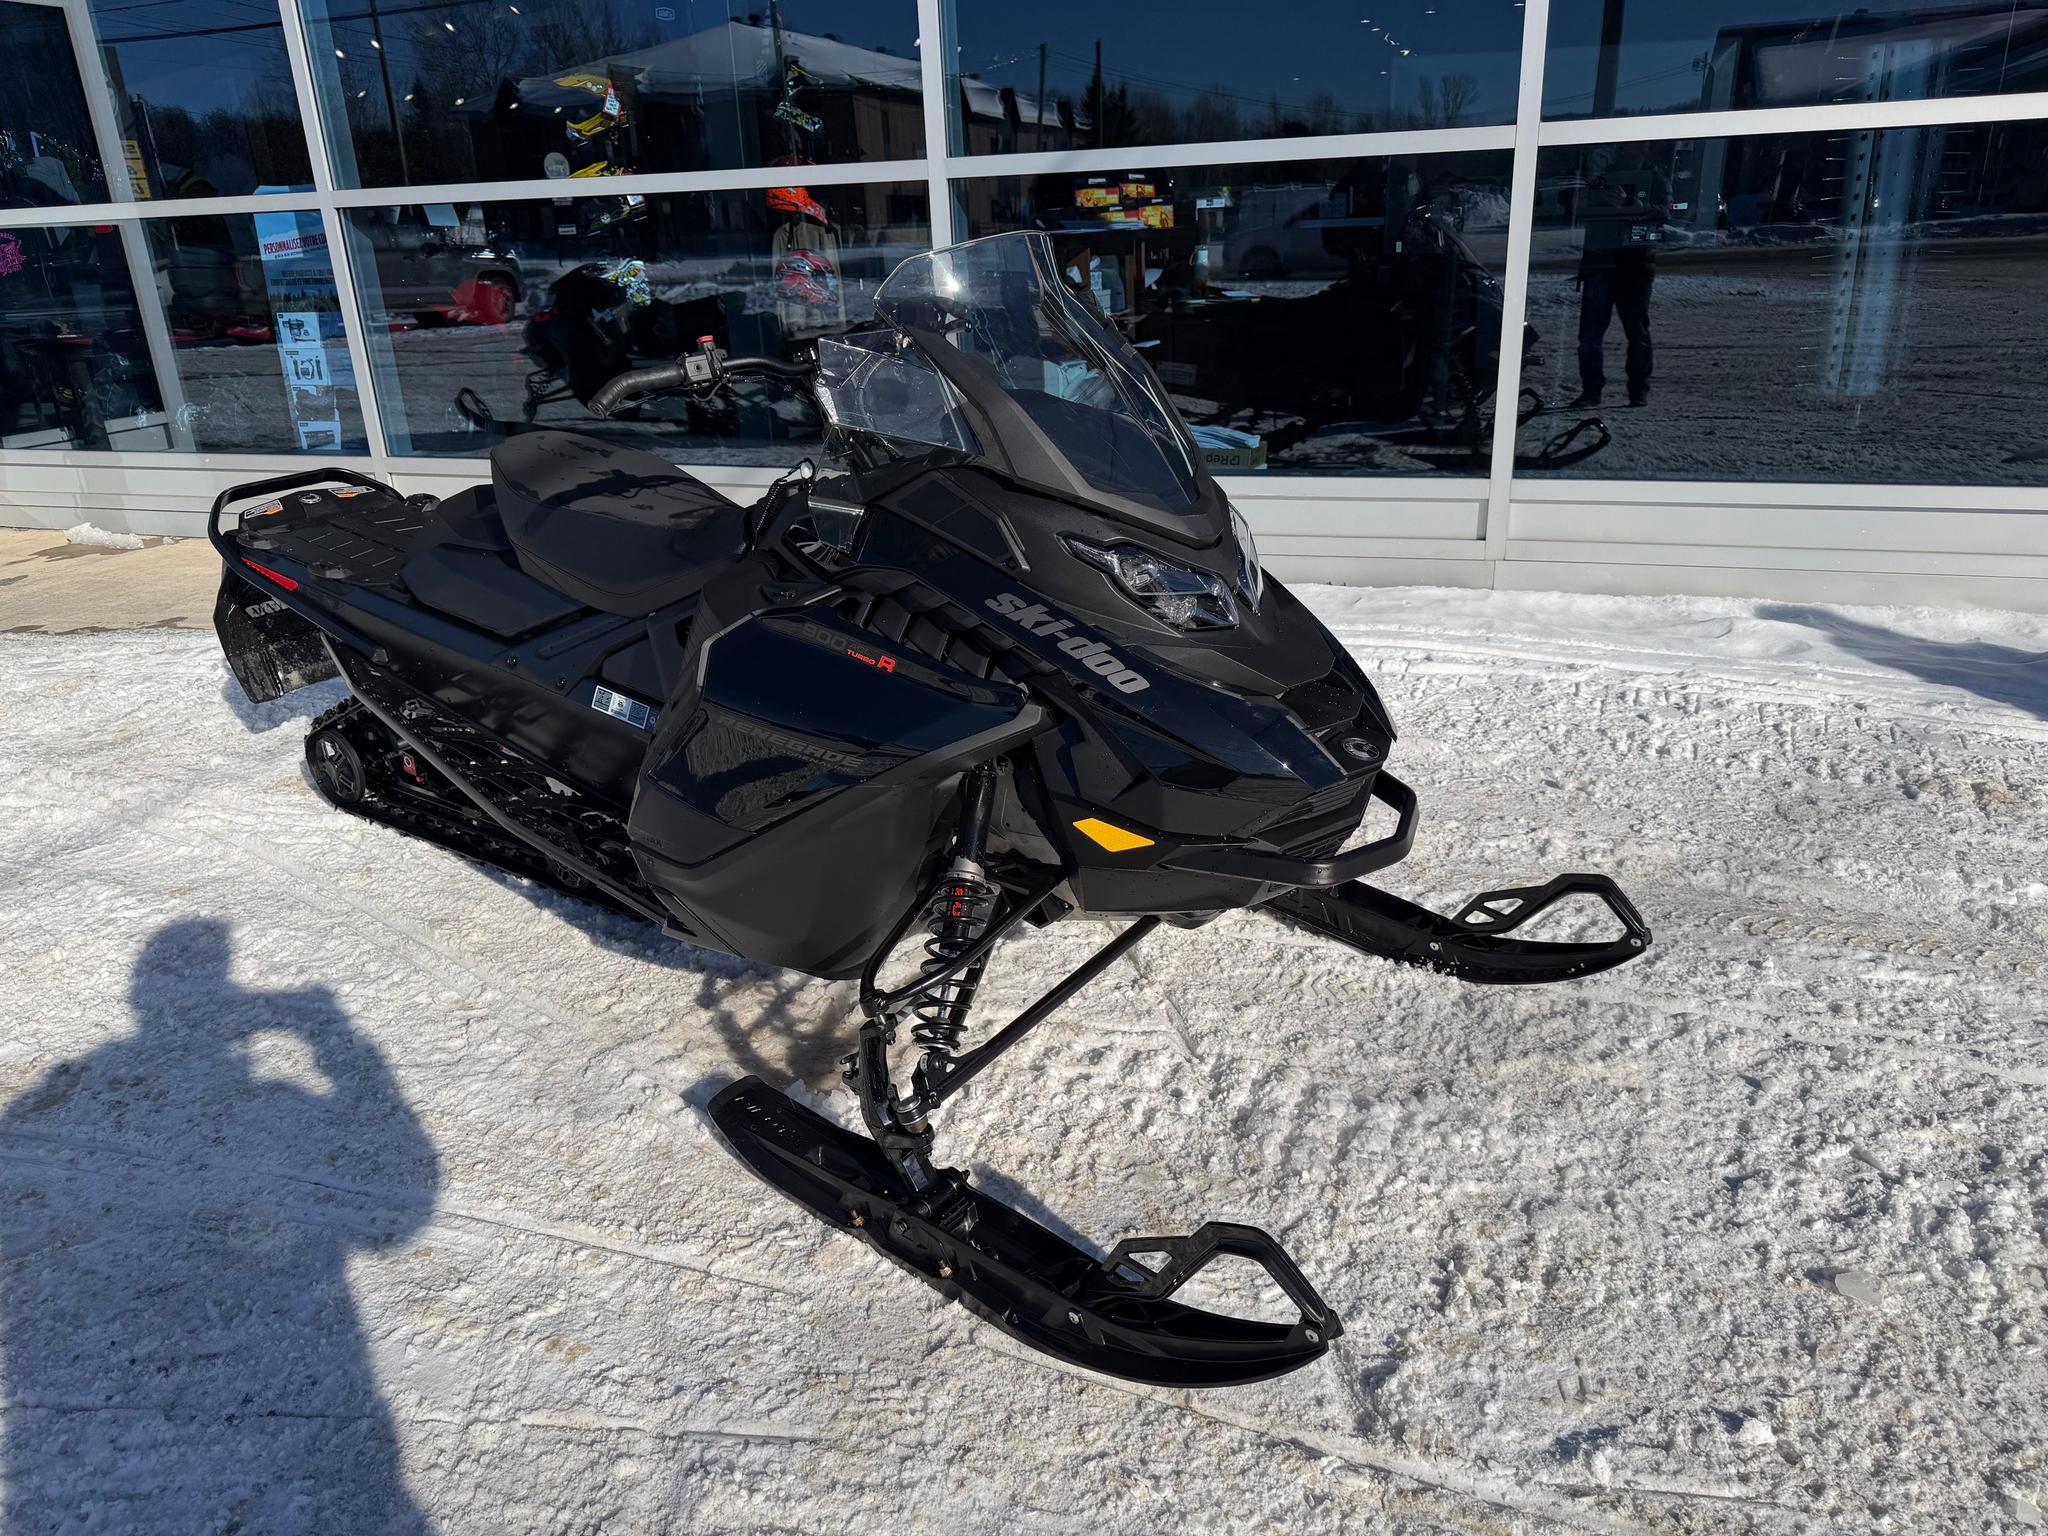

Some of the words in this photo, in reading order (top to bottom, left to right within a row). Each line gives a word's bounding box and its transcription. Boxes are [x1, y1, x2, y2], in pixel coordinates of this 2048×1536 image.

[801, 622, 848, 651] 900
[984, 592, 1150, 694] ski-doo
[847, 648, 876, 665] TURBO
[877, 655, 896, 673] R
[716, 714, 866, 768] RENEGADE
